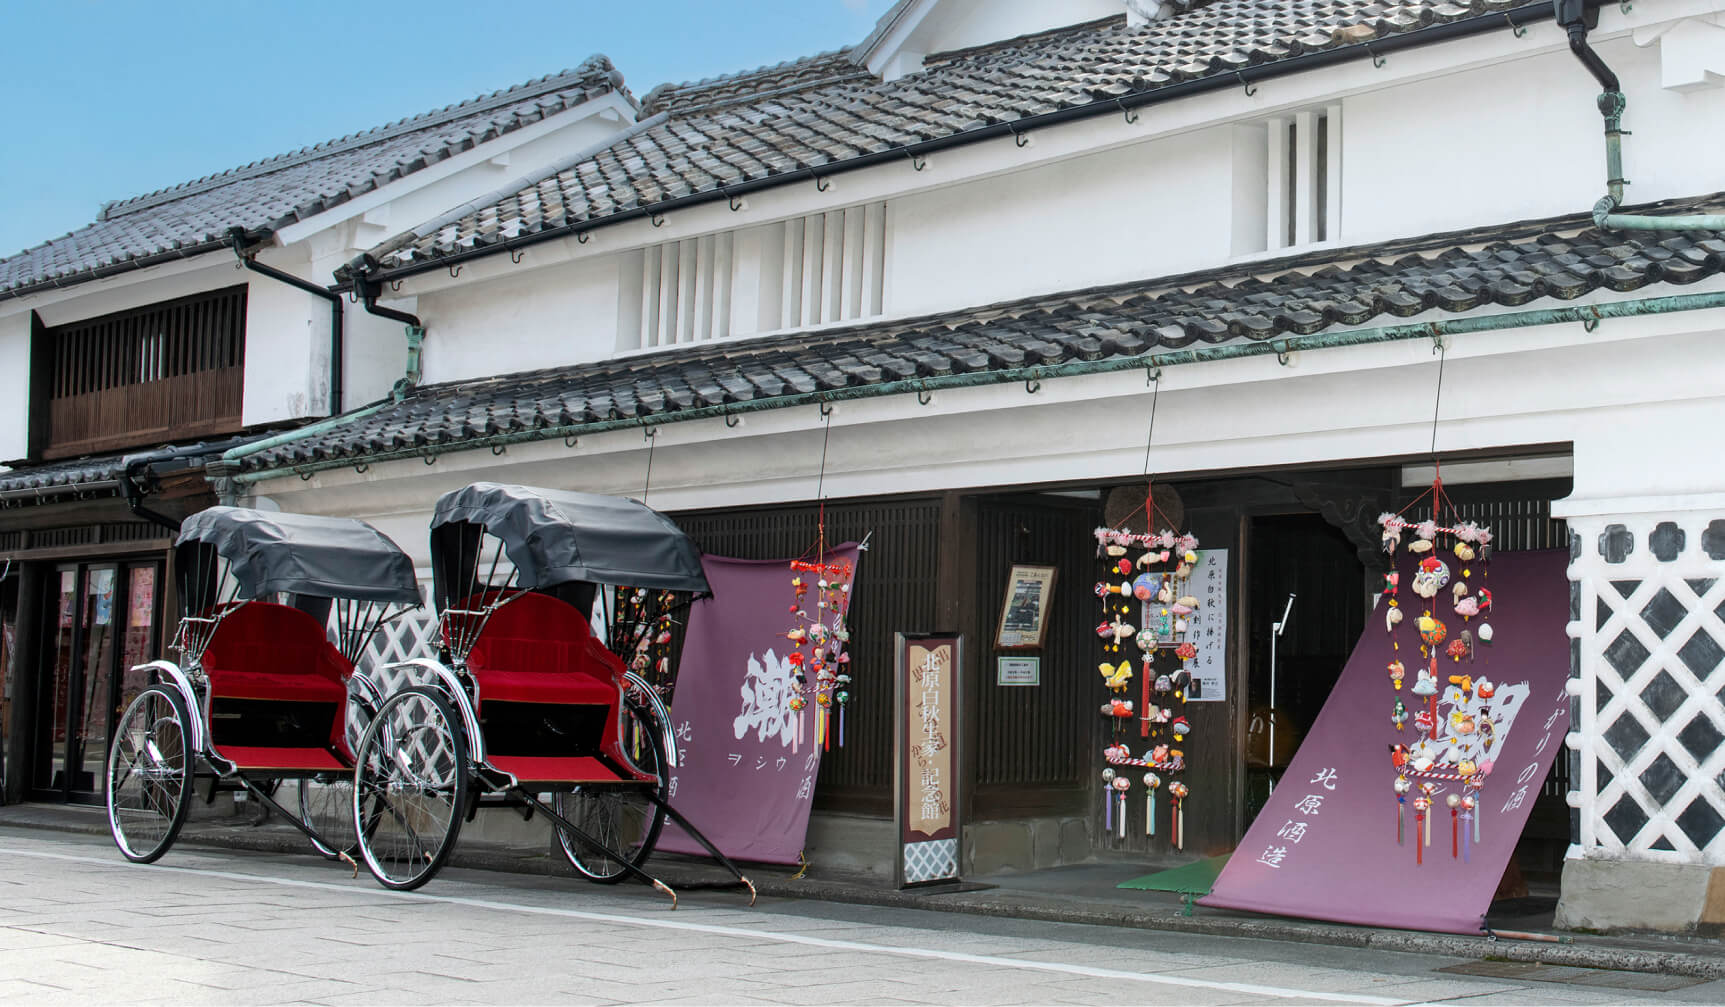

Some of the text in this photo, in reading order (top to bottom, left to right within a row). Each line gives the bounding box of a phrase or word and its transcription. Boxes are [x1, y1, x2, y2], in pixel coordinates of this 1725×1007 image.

[921, 653, 941, 821] 北原白秋生家・記念館
[1255, 767, 1338, 869] 北原酒造
